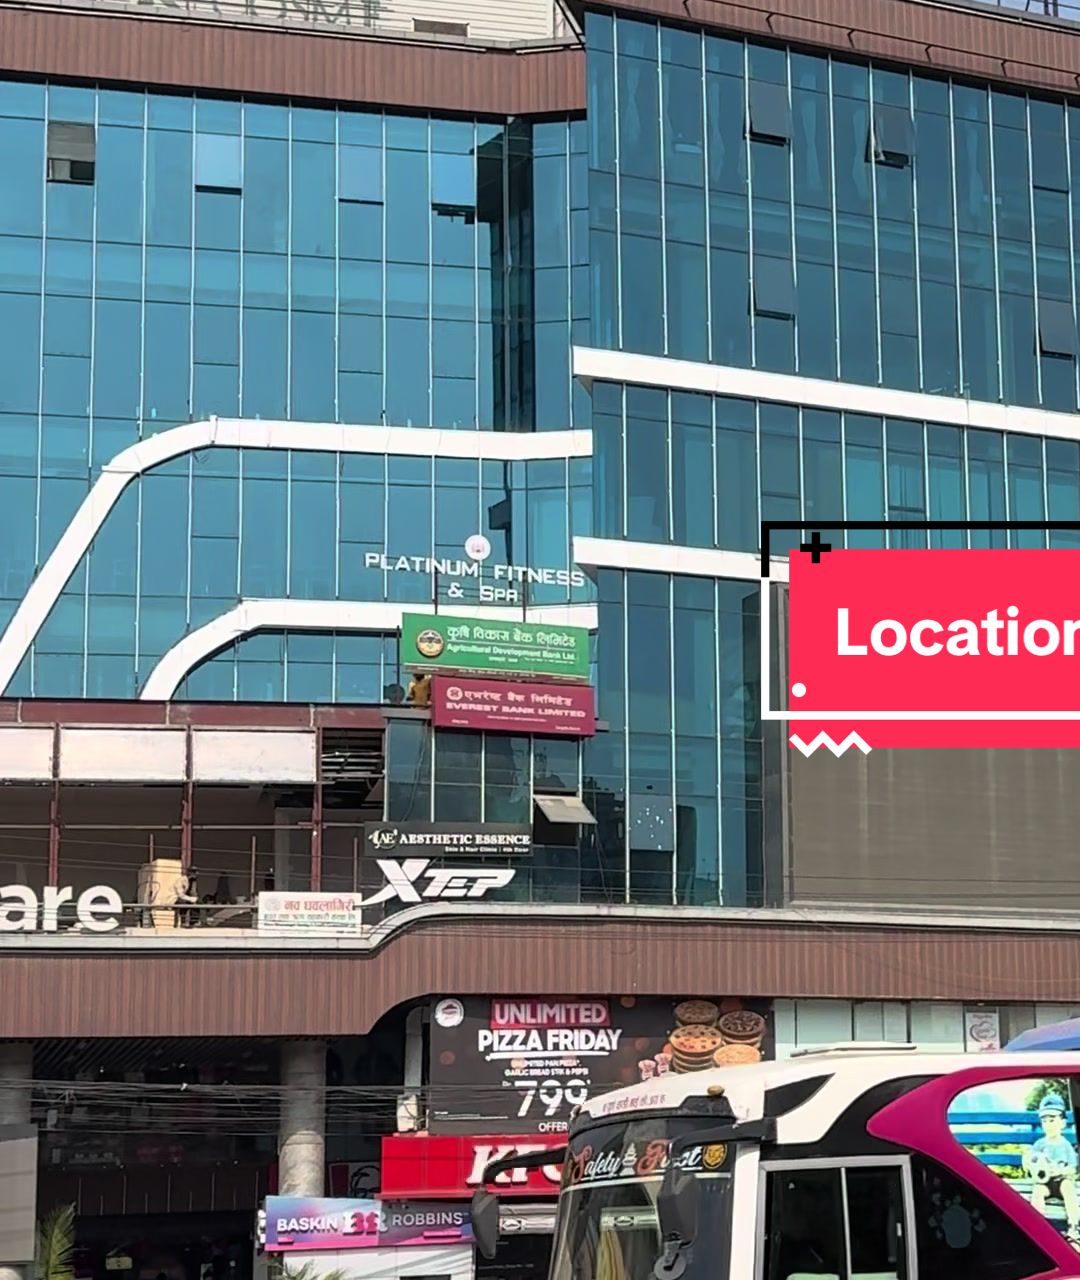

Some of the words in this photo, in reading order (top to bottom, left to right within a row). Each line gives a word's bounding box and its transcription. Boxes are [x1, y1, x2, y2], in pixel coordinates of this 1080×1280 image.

[365, 552, 478, 578] PLATINUM
[494, 564, 585, 587] FITNESS
[448, 583, 464, 598] &
[473, 626, 510, 641] विकास
[446, 702, 499, 712] EVEREST
[502, 705, 534, 715] BANK
[538, 708, 586, 718] LIMITED
[400, 834, 472, 845] AESTHETIC
[475, 834, 531, 845] ESSENCE
[494, 1003, 607, 1024] UNLIMITED
[478, 1029, 543, 1052] PIZZA
[547, 1028, 622, 1051] FRIDAY
[538, 1121, 569, 1133] OFFER
[572, 1145, 621, 1183] Safety
[277, 1216, 338, 1232] BASKIN
[392, 1211, 464, 1227] ROBBINS
